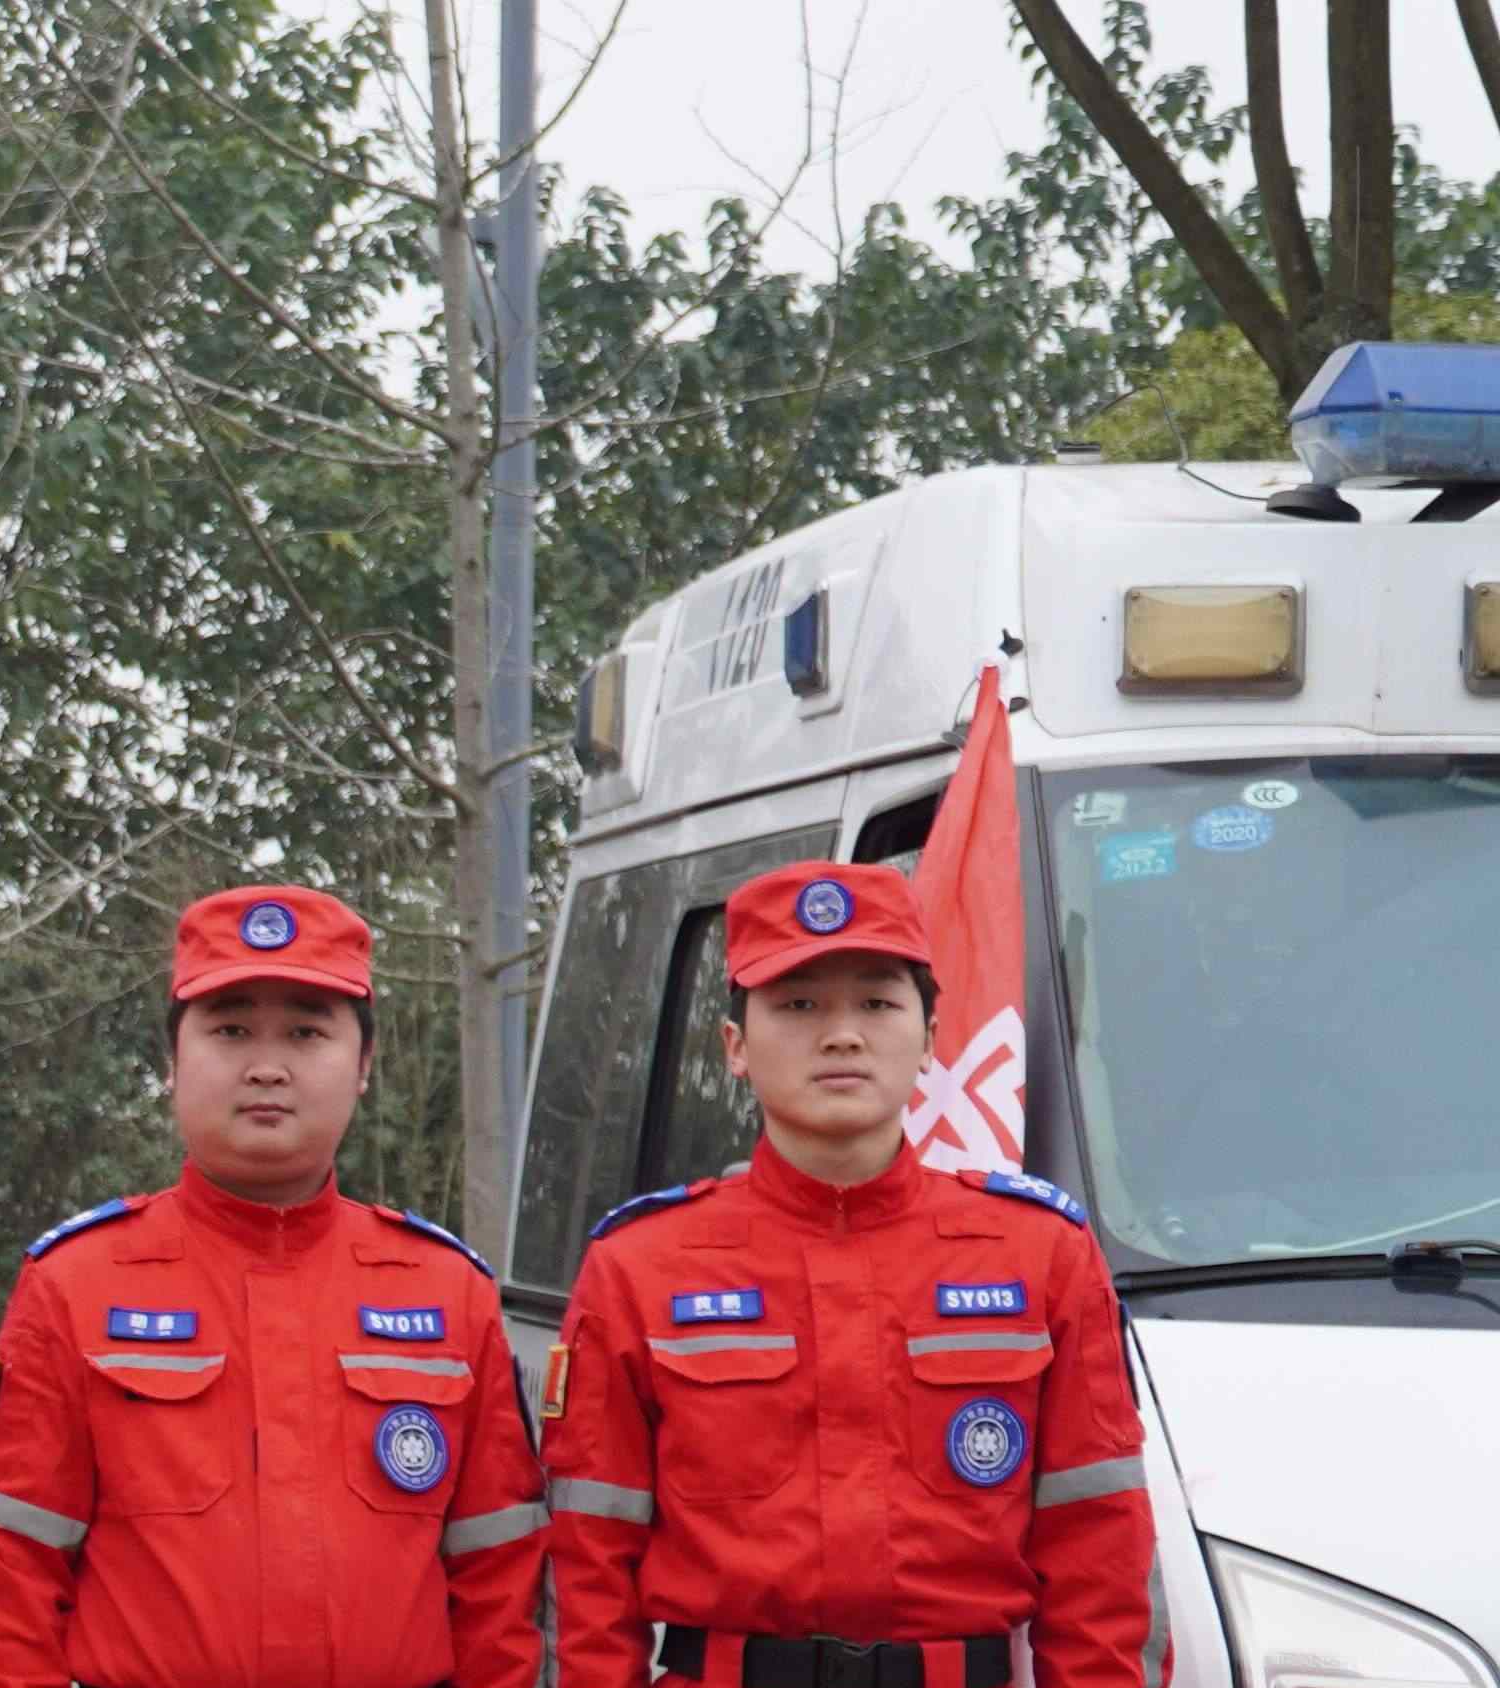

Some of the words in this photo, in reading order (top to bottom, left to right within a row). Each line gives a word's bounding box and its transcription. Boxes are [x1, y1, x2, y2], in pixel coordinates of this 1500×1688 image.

[1211, 825, 1257, 843] 2020
[946, 1289, 1014, 1308] SY013
[368, 1312, 435, 1333] SY011
